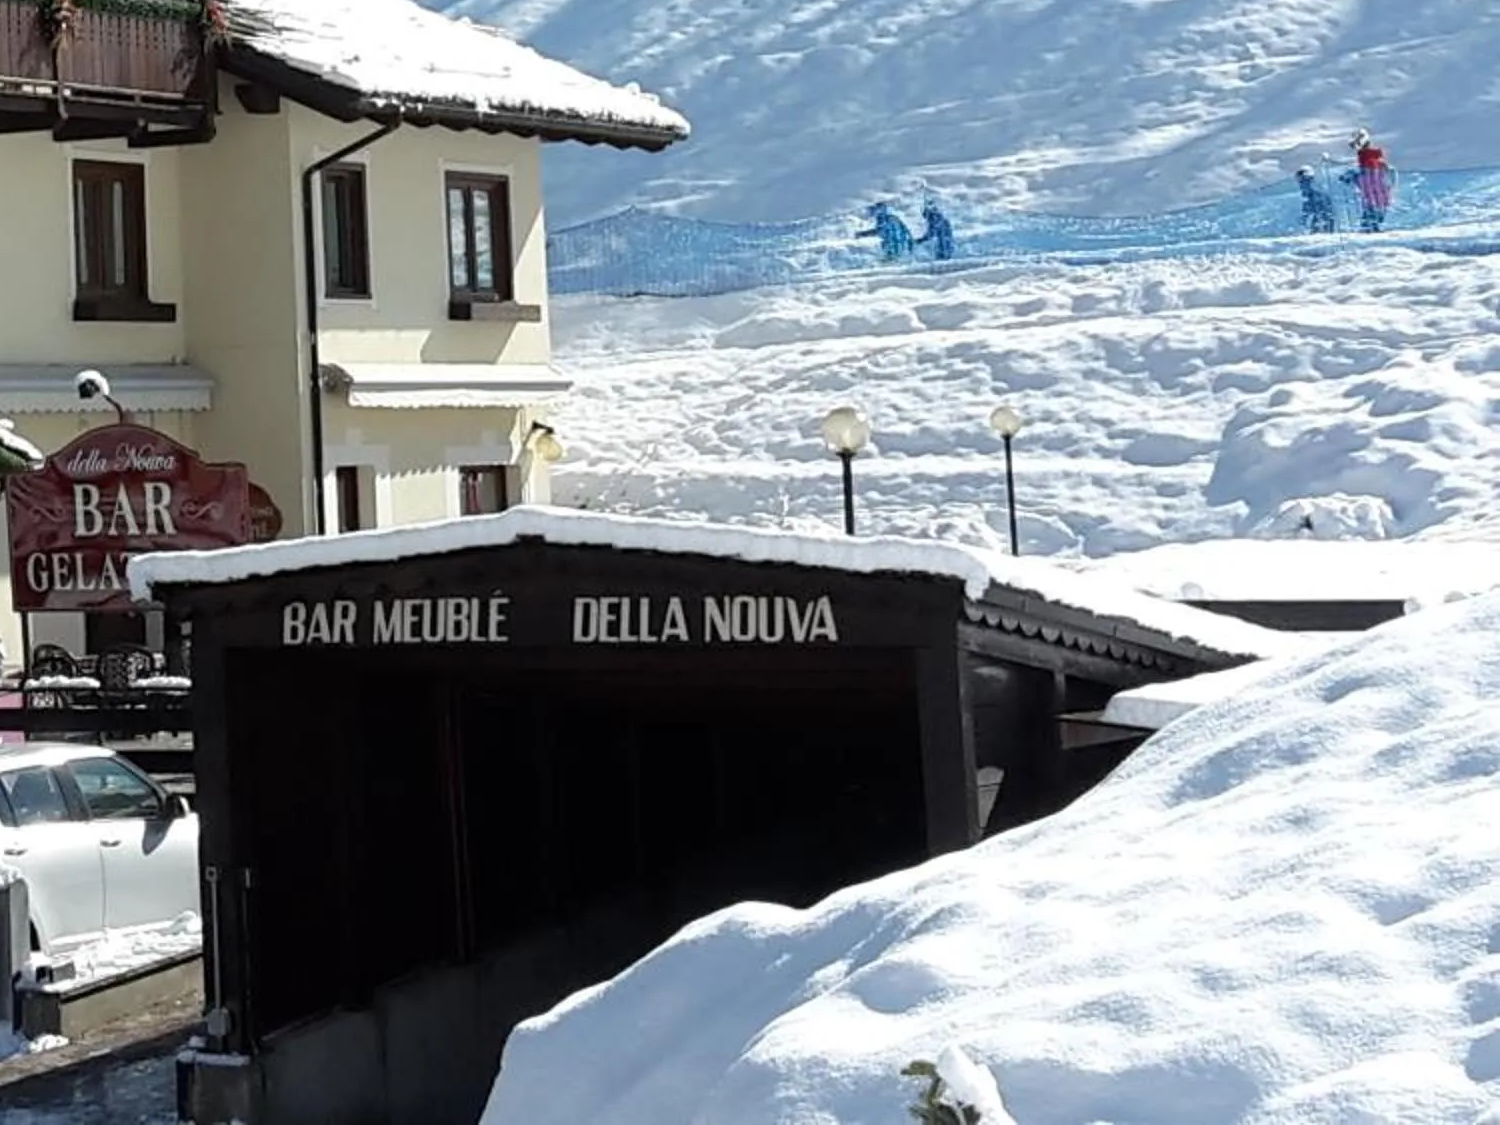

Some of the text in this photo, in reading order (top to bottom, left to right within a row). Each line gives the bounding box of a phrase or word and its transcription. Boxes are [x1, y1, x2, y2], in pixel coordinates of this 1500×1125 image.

[67, 443, 176, 474] della Nouva
[72, 481, 177, 538] BAR
[282, 590, 839, 645] BAR MEUBLÉ DELLA NOUVA
